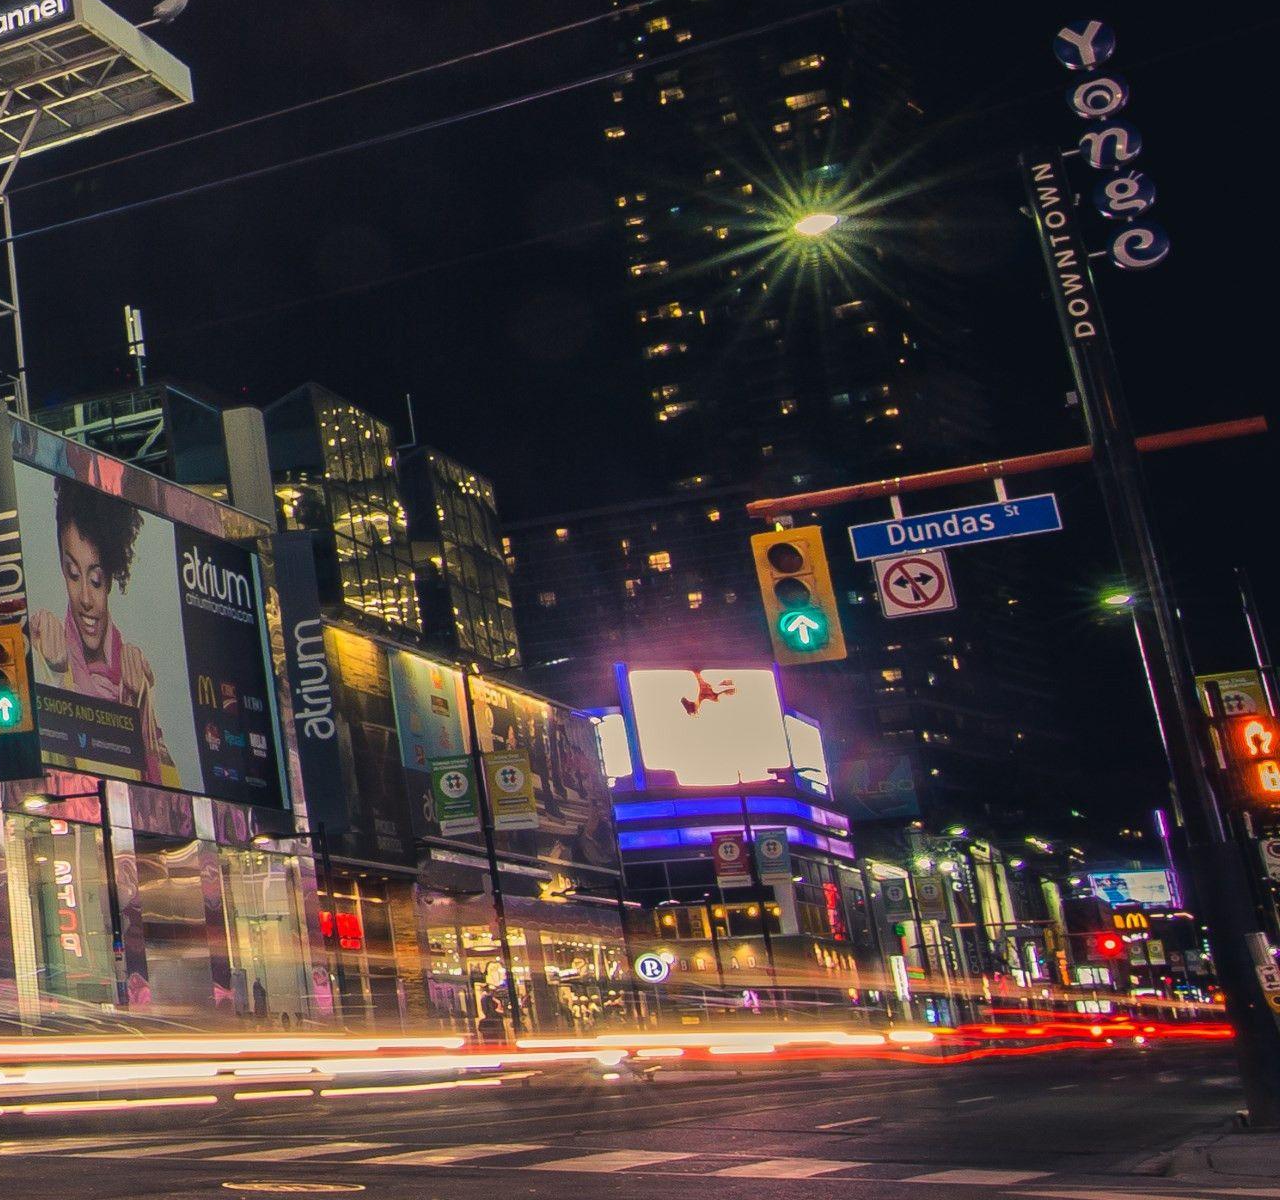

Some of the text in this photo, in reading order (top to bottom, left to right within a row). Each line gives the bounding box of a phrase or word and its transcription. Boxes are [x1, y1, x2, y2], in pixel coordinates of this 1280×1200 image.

[1057, 20, 1170, 270] Yonge
[1031, 162, 1096, 339] DOWNTOWN
[886, 504, 1020, 547] Dundas St
[182, 545, 252, 610] atrium
[44, 696, 74, 718] SHOPS
[75, 704, 94, 722] AND
[95, 708, 134, 732] SERVICES
[294, 619, 334, 740] atrium
